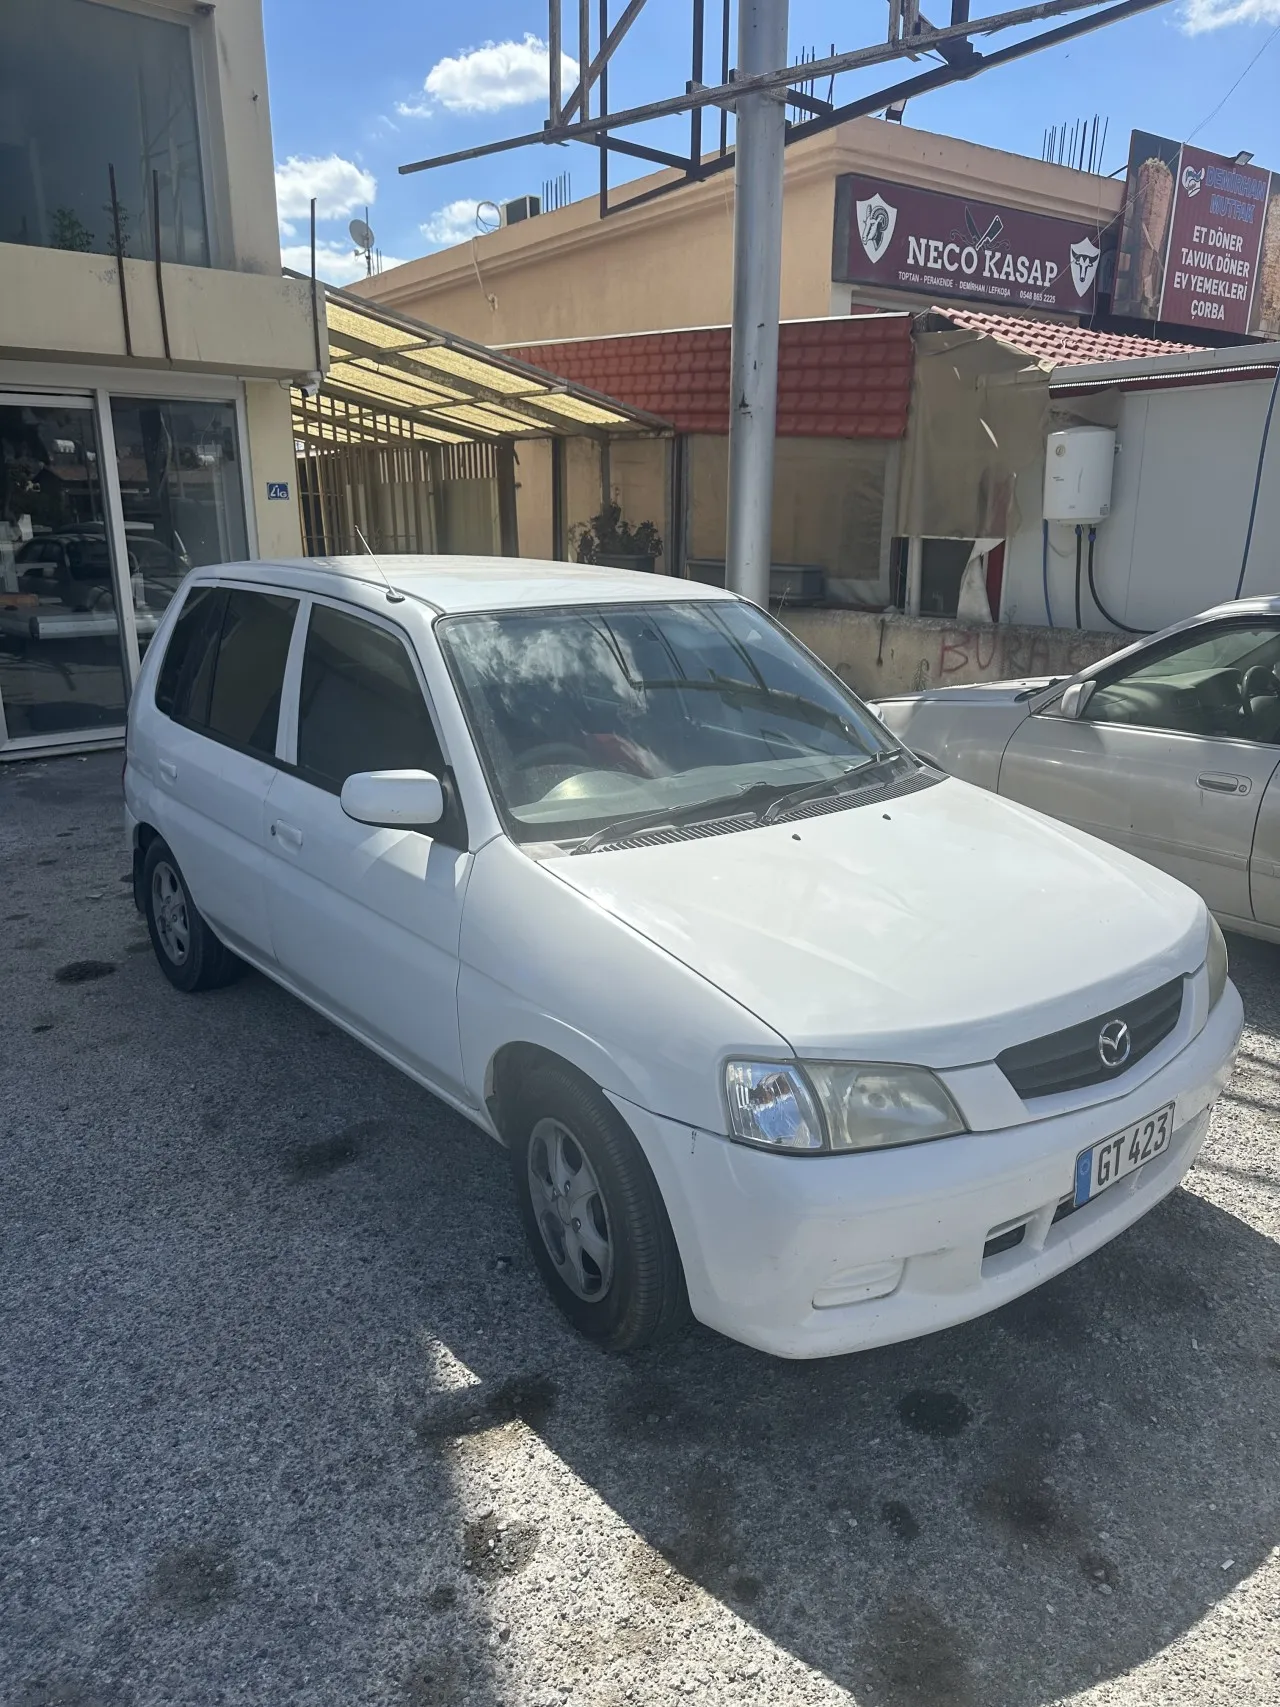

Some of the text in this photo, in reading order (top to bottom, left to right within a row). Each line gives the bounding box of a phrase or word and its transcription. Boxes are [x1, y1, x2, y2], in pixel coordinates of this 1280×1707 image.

[1209, 193, 1256, 224] MUTFAK
[1192, 225, 1244, 253] ET DÖNER
[906, 236, 1058, 288] NECO KASAP
[1181, 248, 1250, 278] TAVUK DÖNER
[898, 271, 920, 283] TOPTAN
[923, 274, 954, 288] PERAKENDE
[1173, 271, 1249, 301] EV YEMEKLERİ
[1190, 299, 1225, 320] ÇORBA
[1097, 1112, 1169, 1186] GT 423
